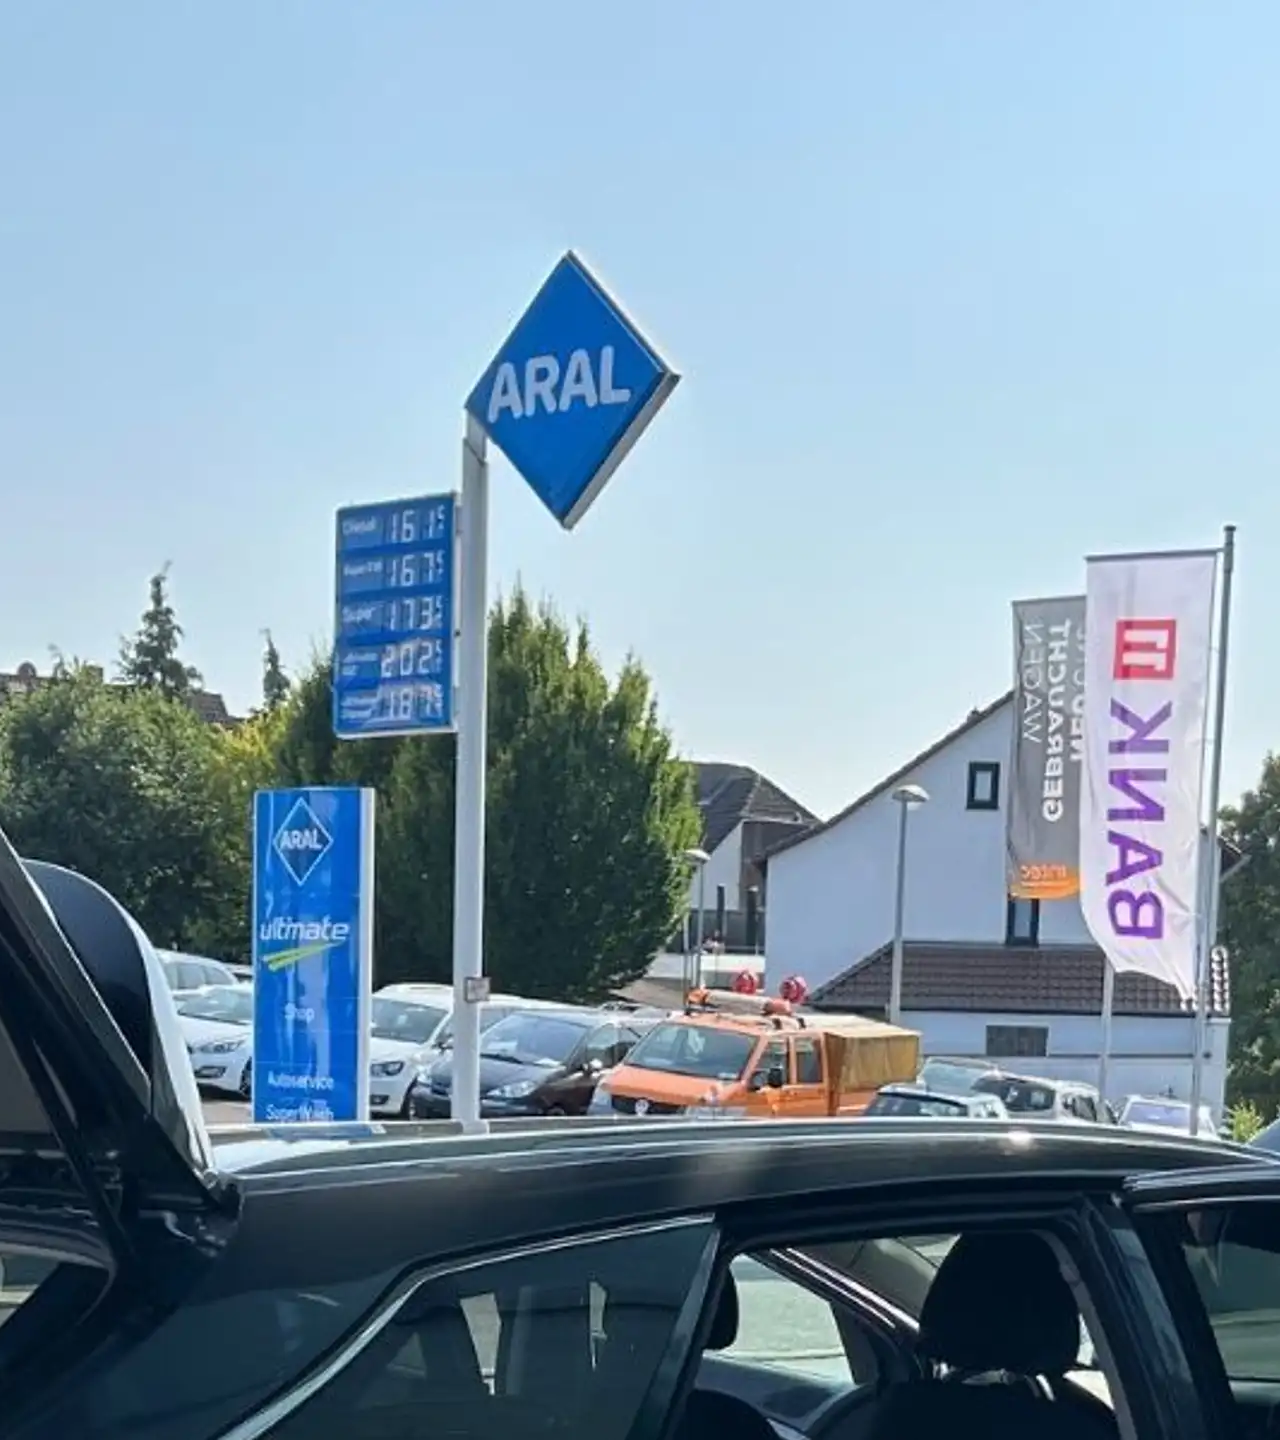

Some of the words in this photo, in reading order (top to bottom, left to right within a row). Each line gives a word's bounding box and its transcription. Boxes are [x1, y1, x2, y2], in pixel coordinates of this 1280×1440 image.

[487, 344, 632, 424] ARAL
[280, 829, 323, 850] ARAL
[259, 915, 351, 941] ultimate
[284, 1002, 315, 1023] Shop
